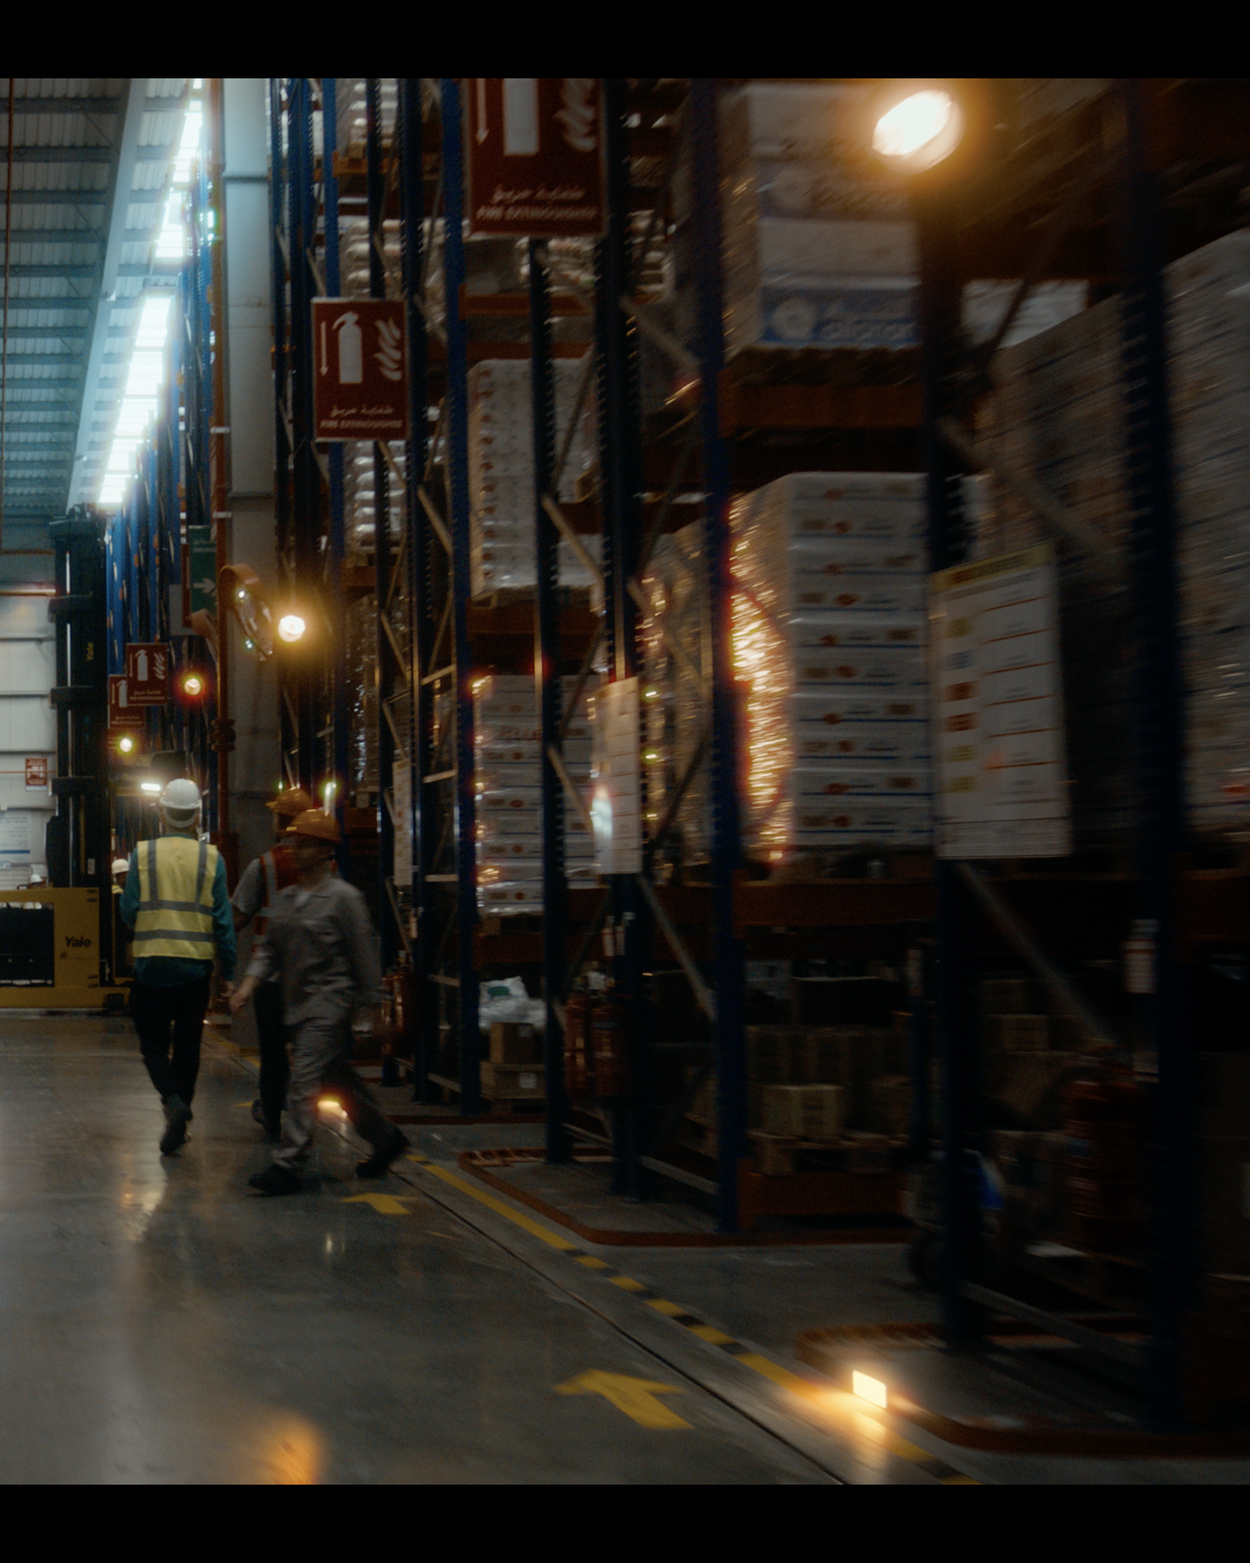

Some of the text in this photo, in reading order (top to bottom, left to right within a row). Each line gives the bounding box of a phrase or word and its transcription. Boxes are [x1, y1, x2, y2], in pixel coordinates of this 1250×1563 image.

[476, 205, 504, 220] FIRE
[320, 419, 403, 429] FIRE EXTINGUISHER
[65, 936, 92, 948] Yale
